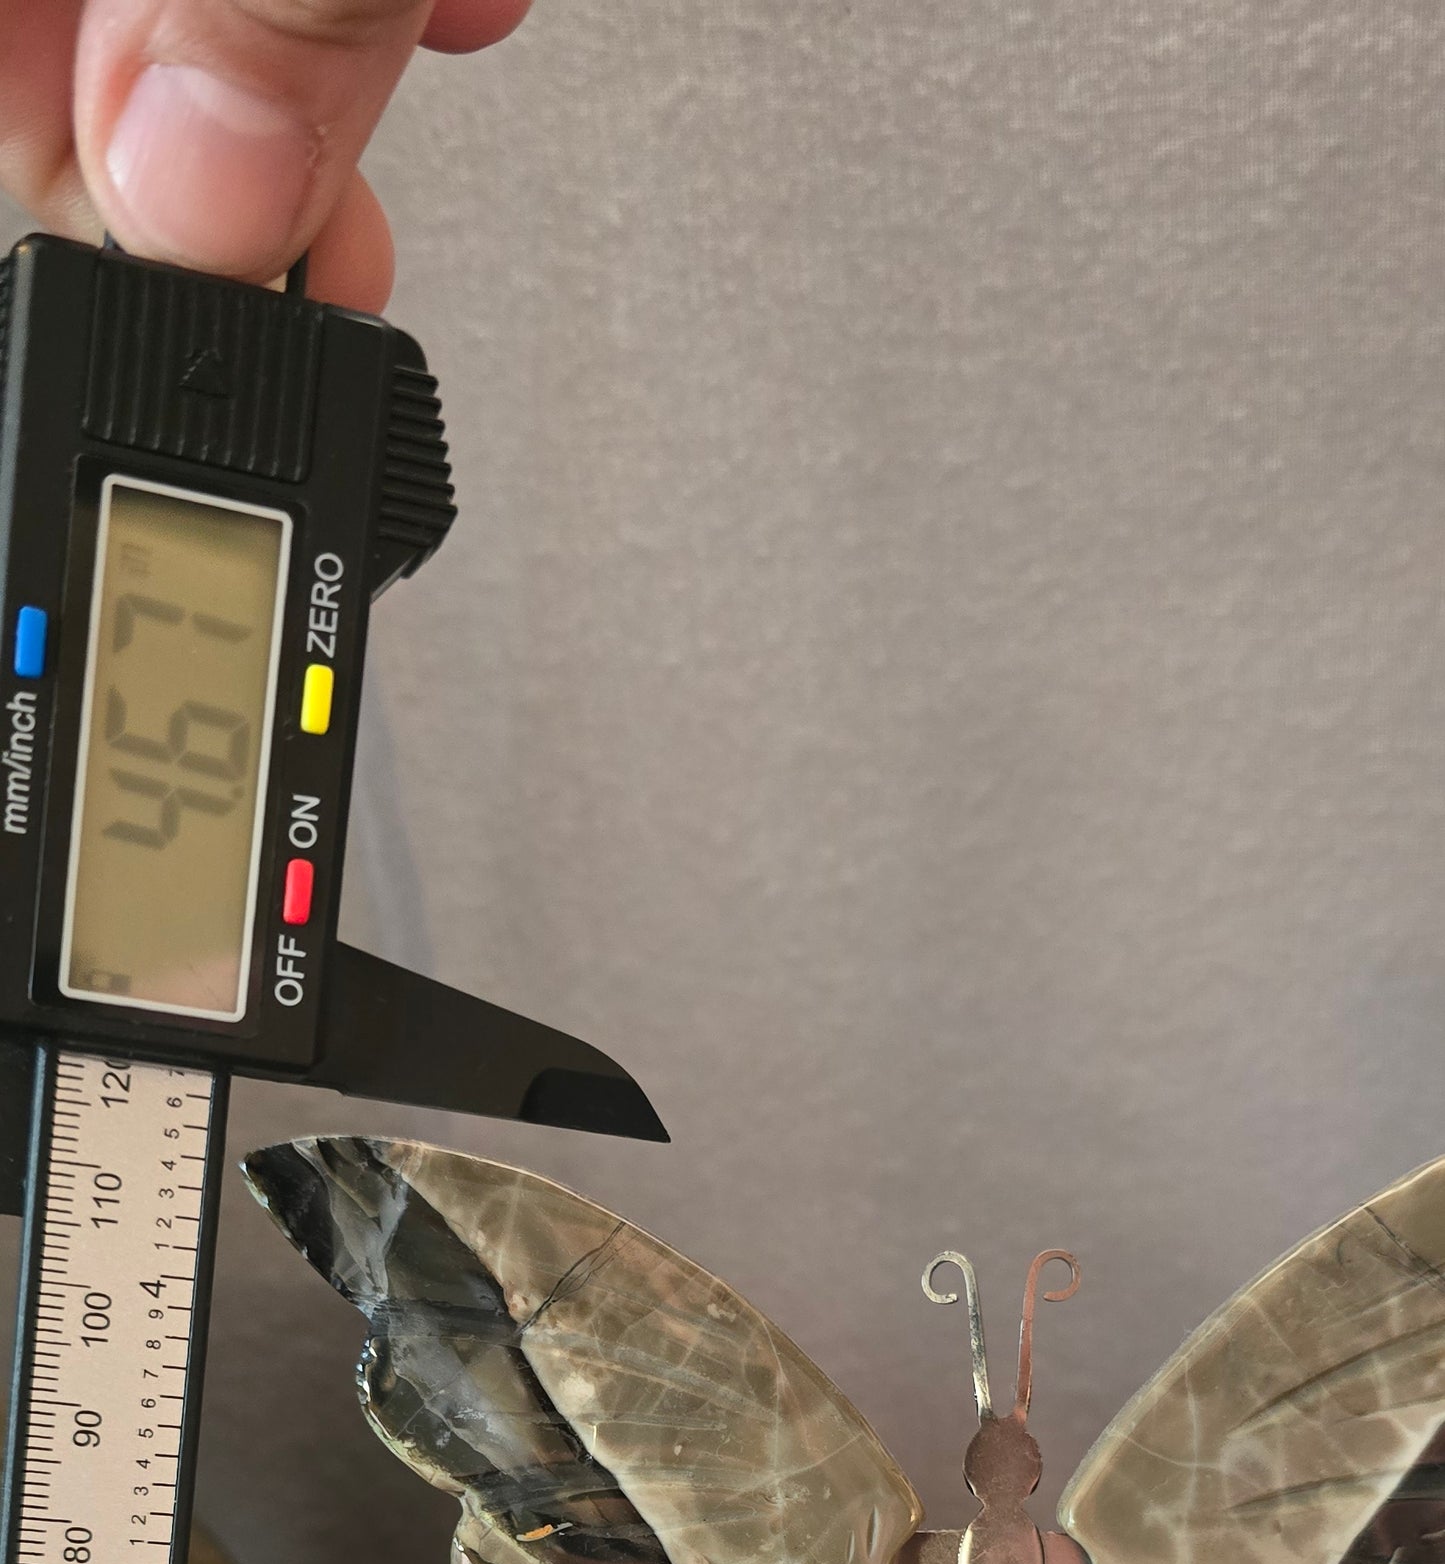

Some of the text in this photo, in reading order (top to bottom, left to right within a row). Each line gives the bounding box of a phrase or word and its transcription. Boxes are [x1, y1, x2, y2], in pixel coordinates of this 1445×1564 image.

[306, 552, 344, 659] ZERO
[1, 691, 37, 835] mm/inch
[288, 794, 321, 849] ON
[274, 934, 307, 1007] OFF
[165, 1096, 183, 1109] 6
[163, 1128, 180, 1140] 5
[160, 1160, 177, 1171] 4
[158, 1187, 175, 1199] 3
[91, 1173, 122, 1228] 110
[155, 1217, 172, 1230] 2
[153, 1242, 170, 1250] 1
[138, 1279, 167, 1299] 4
[80, 1291, 113, 1348] 100
[147, 1308, 165, 1320] 9
[145, 1339, 162, 1350] 8
[143, 1368, 159, 1379] 7
[140, 1398, 157, 1409] 6
[72, 1410, 103, 1448] 90
[137, 1428, 154, 1439] 5
[135, 1458, 151, 1470] 4
[133, 1486, 149, 1497] 3
[130, 1514, 147, 1526] 2
[62, 1526, 93, 1564] 80
[129, 1538, 145, 1546] 1
